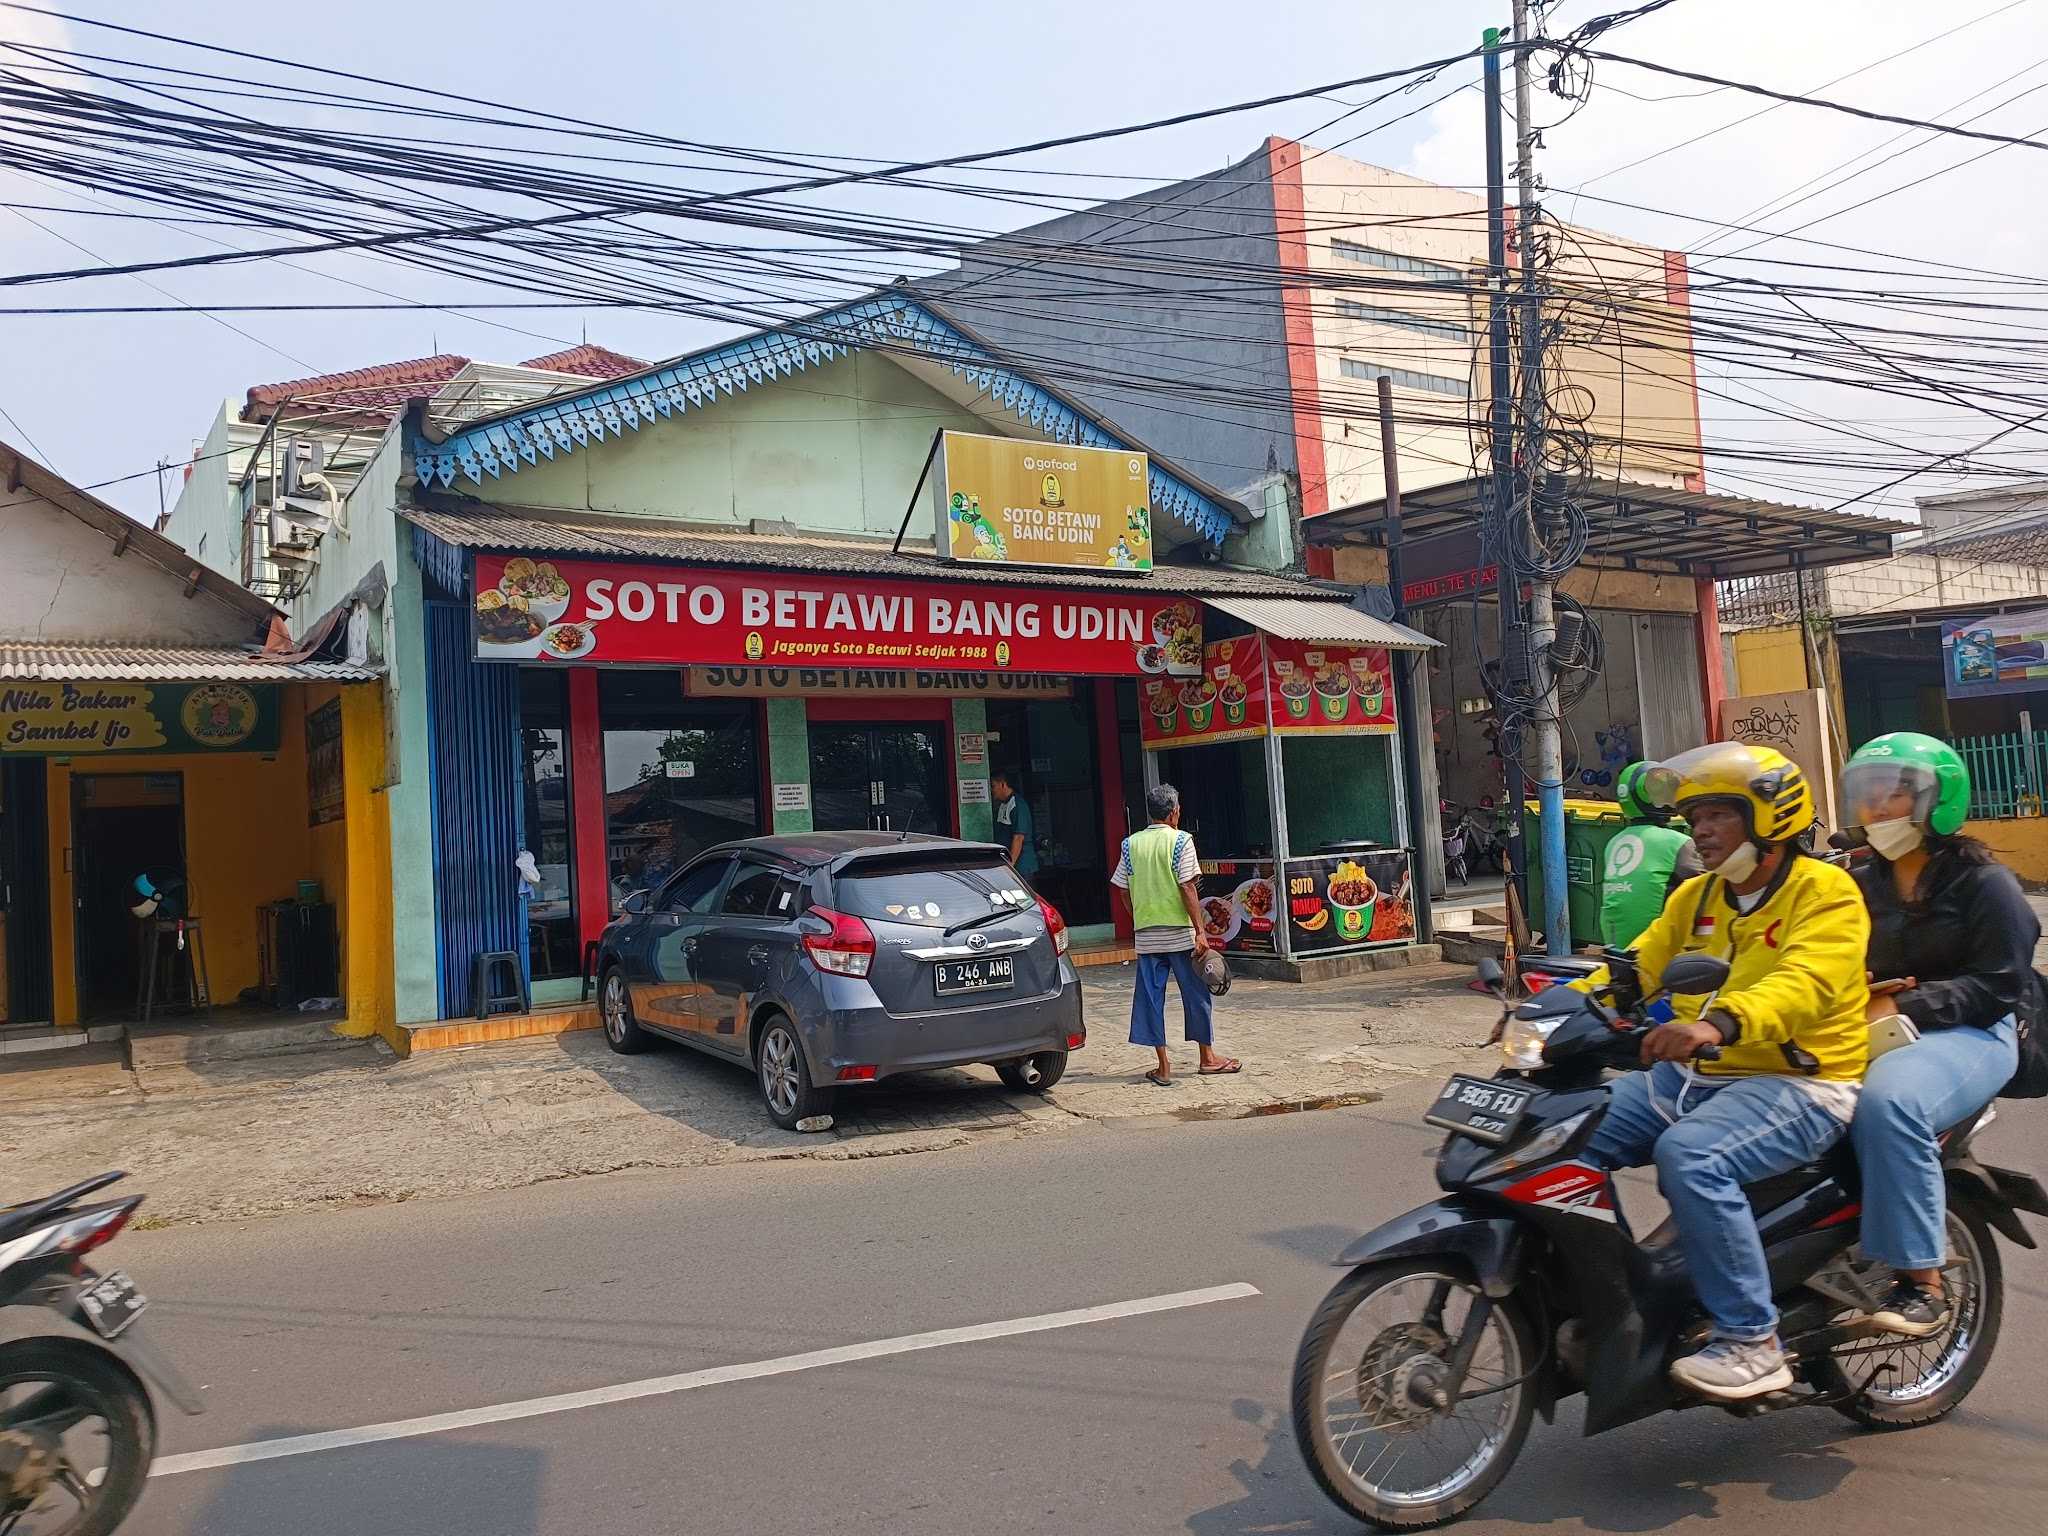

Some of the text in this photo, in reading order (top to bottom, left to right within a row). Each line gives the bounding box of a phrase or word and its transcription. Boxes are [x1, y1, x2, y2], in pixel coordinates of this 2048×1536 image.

[1036, 459, 1077, 472] gofood
[1003, 507, 1101, 529] SOTO BETAWI
[1012, 524, 1094, 544] BANG UDIN
[1402, 583, 1438, 602] MENU
[585, 579, 1144, 642] SOTO BETAWI BANG UDIN
[770, 639, 988, 660] Jagonya Soto Betawi Sedjak 1988
[706, 668, 790, 687] SOTO
[799, 669, 907, 688] BETAWI
[916, 673, 987, 690] BANG
[1, 688, 137, 712] Nila Bakar
[6, 720, 131, 747] Sambel Ijo
[1290, 877, 1314, 895] SOTO
[939, 960, 1011, 983] B 246 ANB
[1442, 1083, 1460, 1098] B
